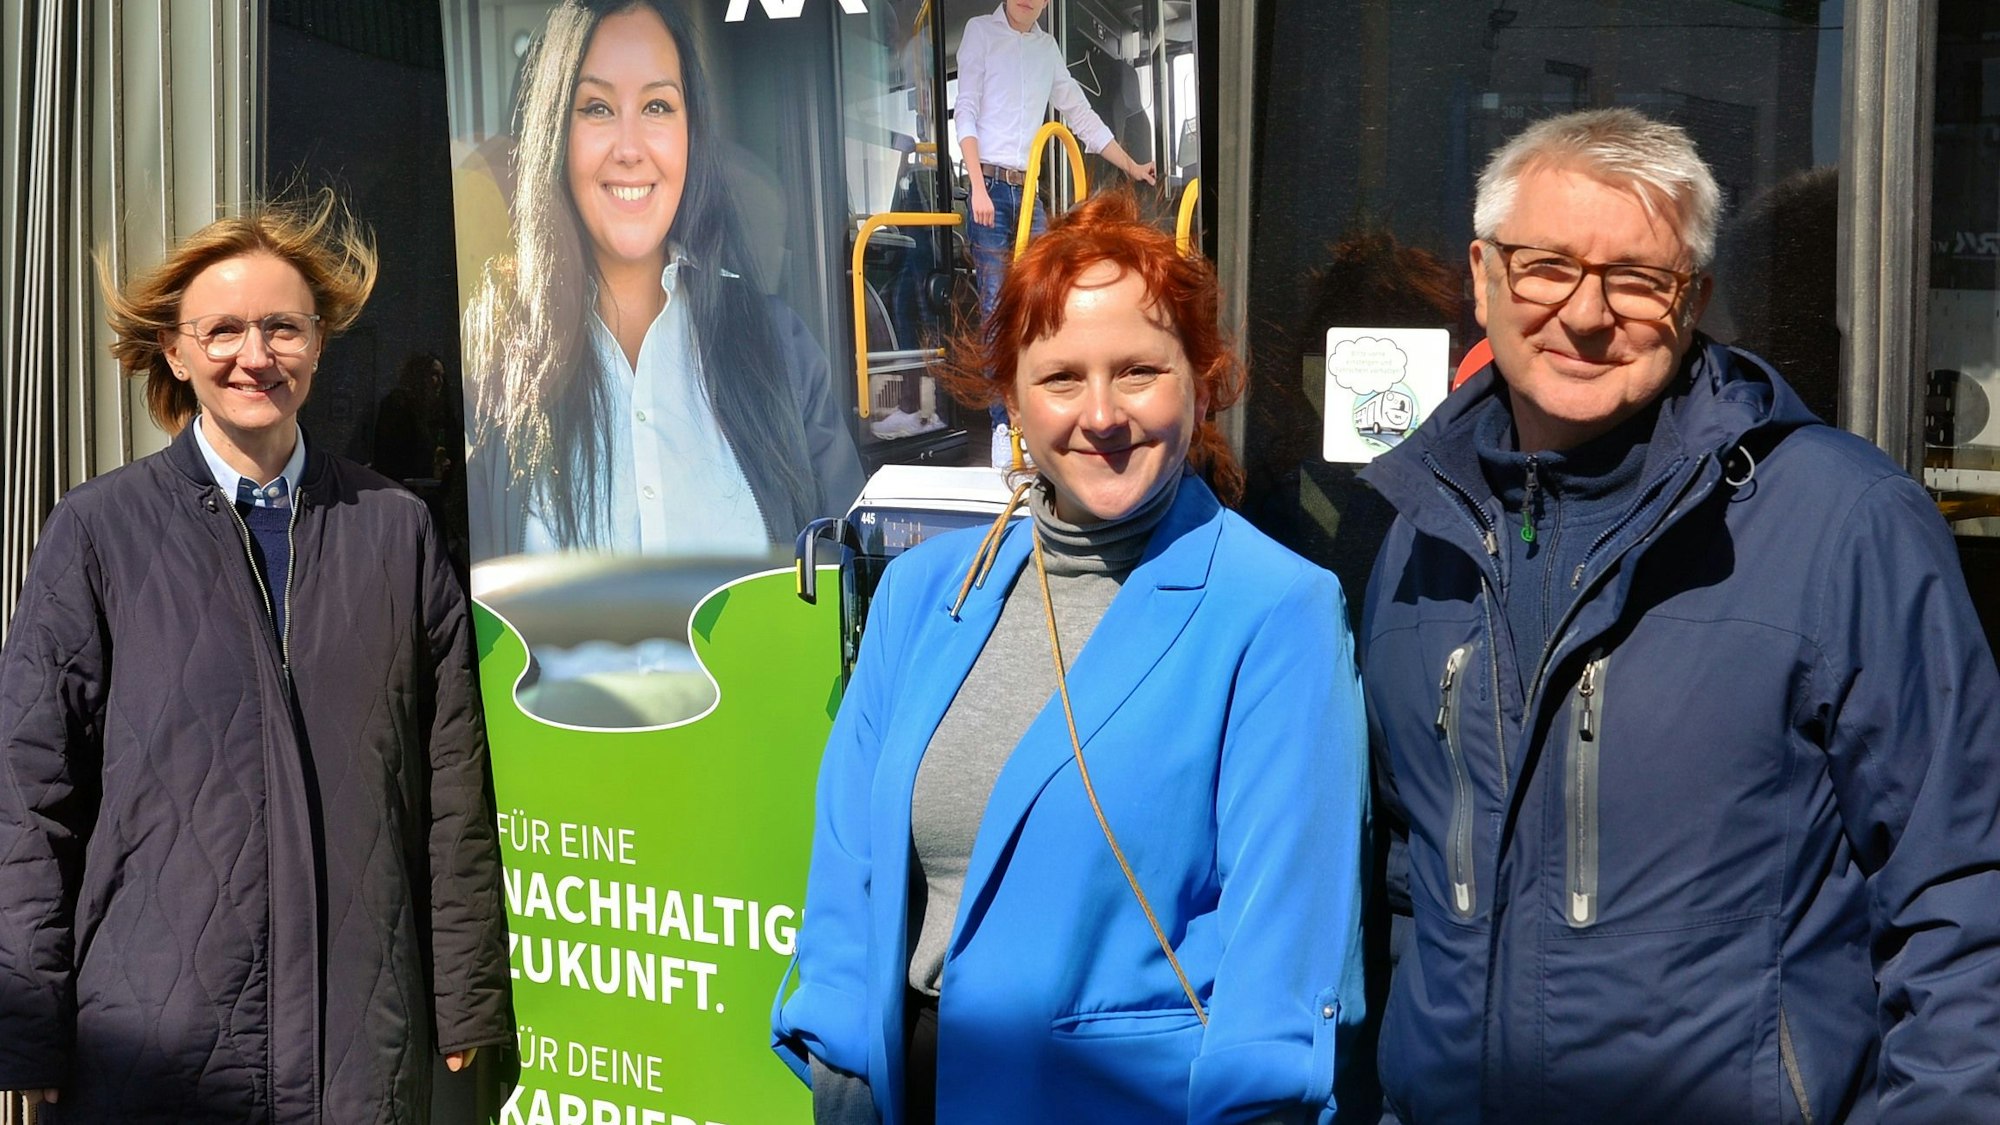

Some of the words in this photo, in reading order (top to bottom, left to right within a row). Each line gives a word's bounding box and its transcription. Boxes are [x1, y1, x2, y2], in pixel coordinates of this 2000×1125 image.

[861, 512, 876, 525] 445
[497, 808, 551, 855] FÜR
[560, 822, 636, 865] EINE
[503, 866, 805, 955] NACHHALTIG
[509, 932, 725, 1014] ZUKUNFT.
[568, 1041, 664, 1093] DEINE
